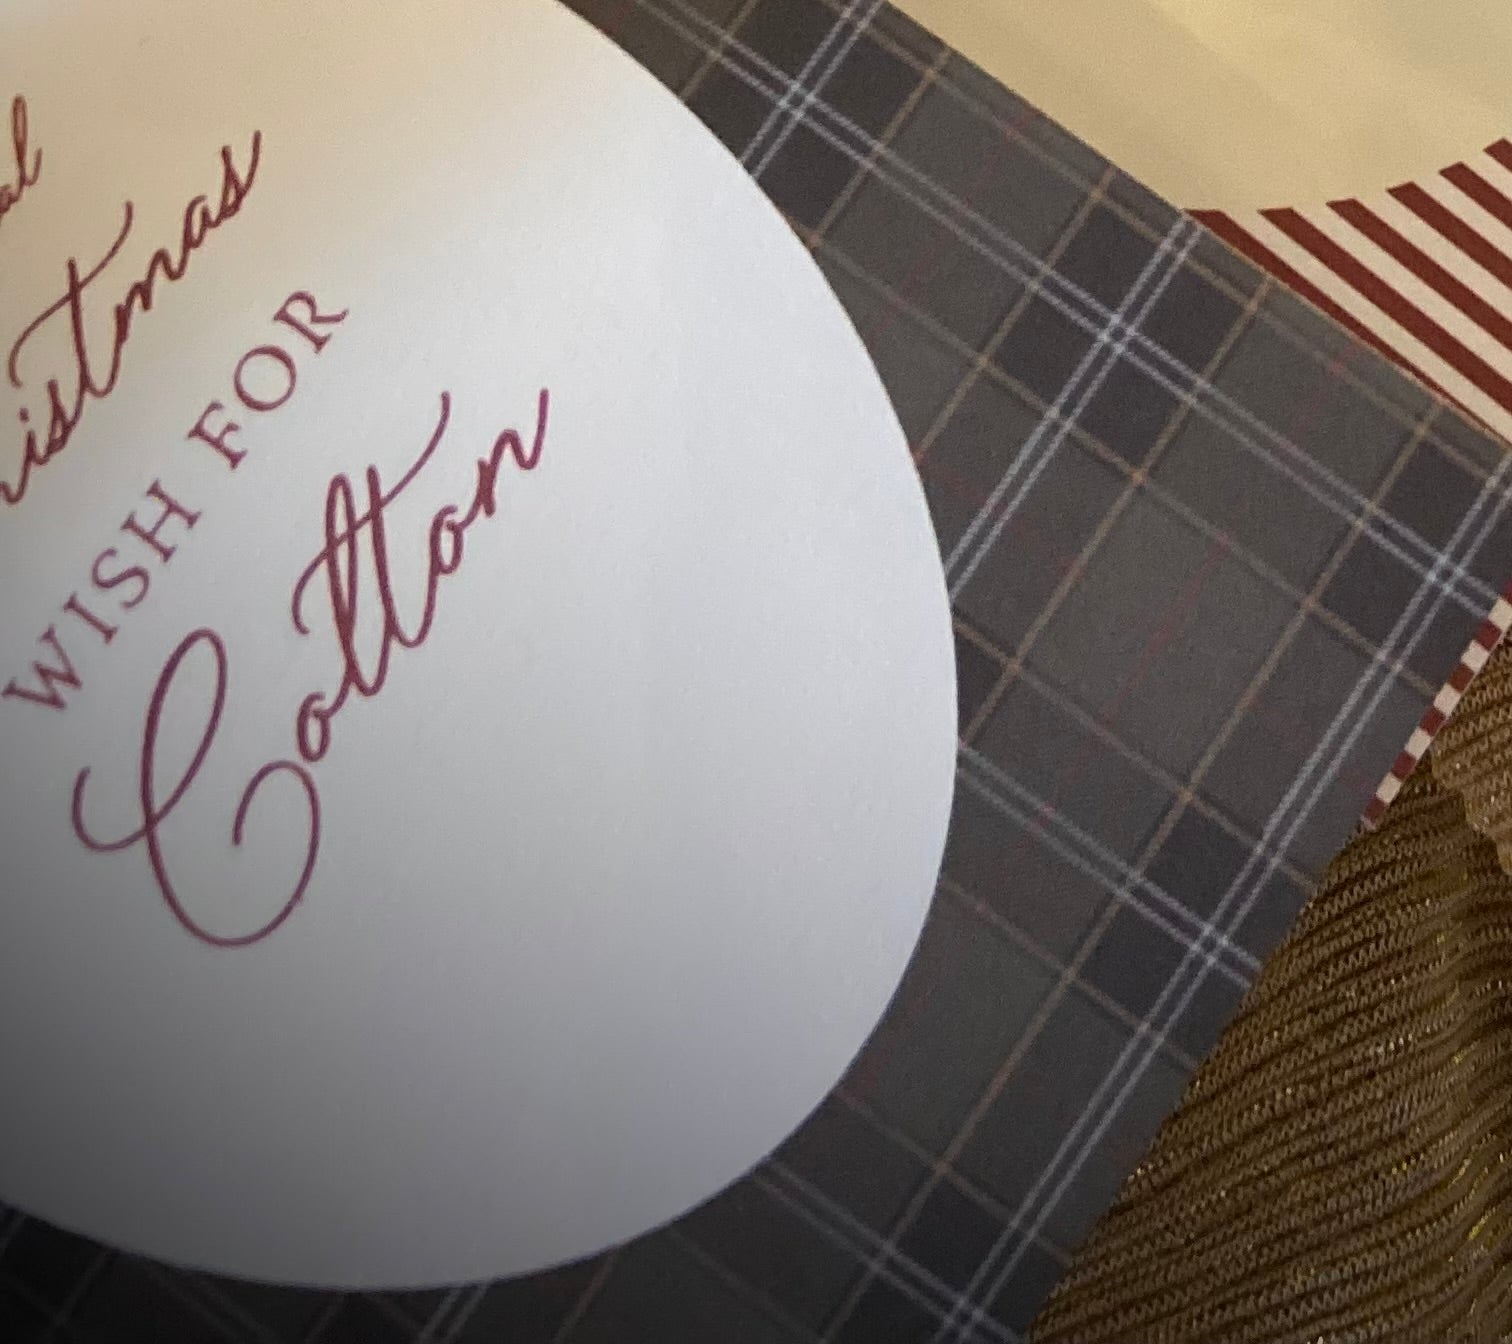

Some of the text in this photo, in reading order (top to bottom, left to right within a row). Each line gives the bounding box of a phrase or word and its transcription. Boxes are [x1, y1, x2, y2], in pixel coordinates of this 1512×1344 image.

[0, 129, 262, 505] istmas
[2, 288, 350, 716] WISH FOR
[71, 387, 550, 949] Colton
